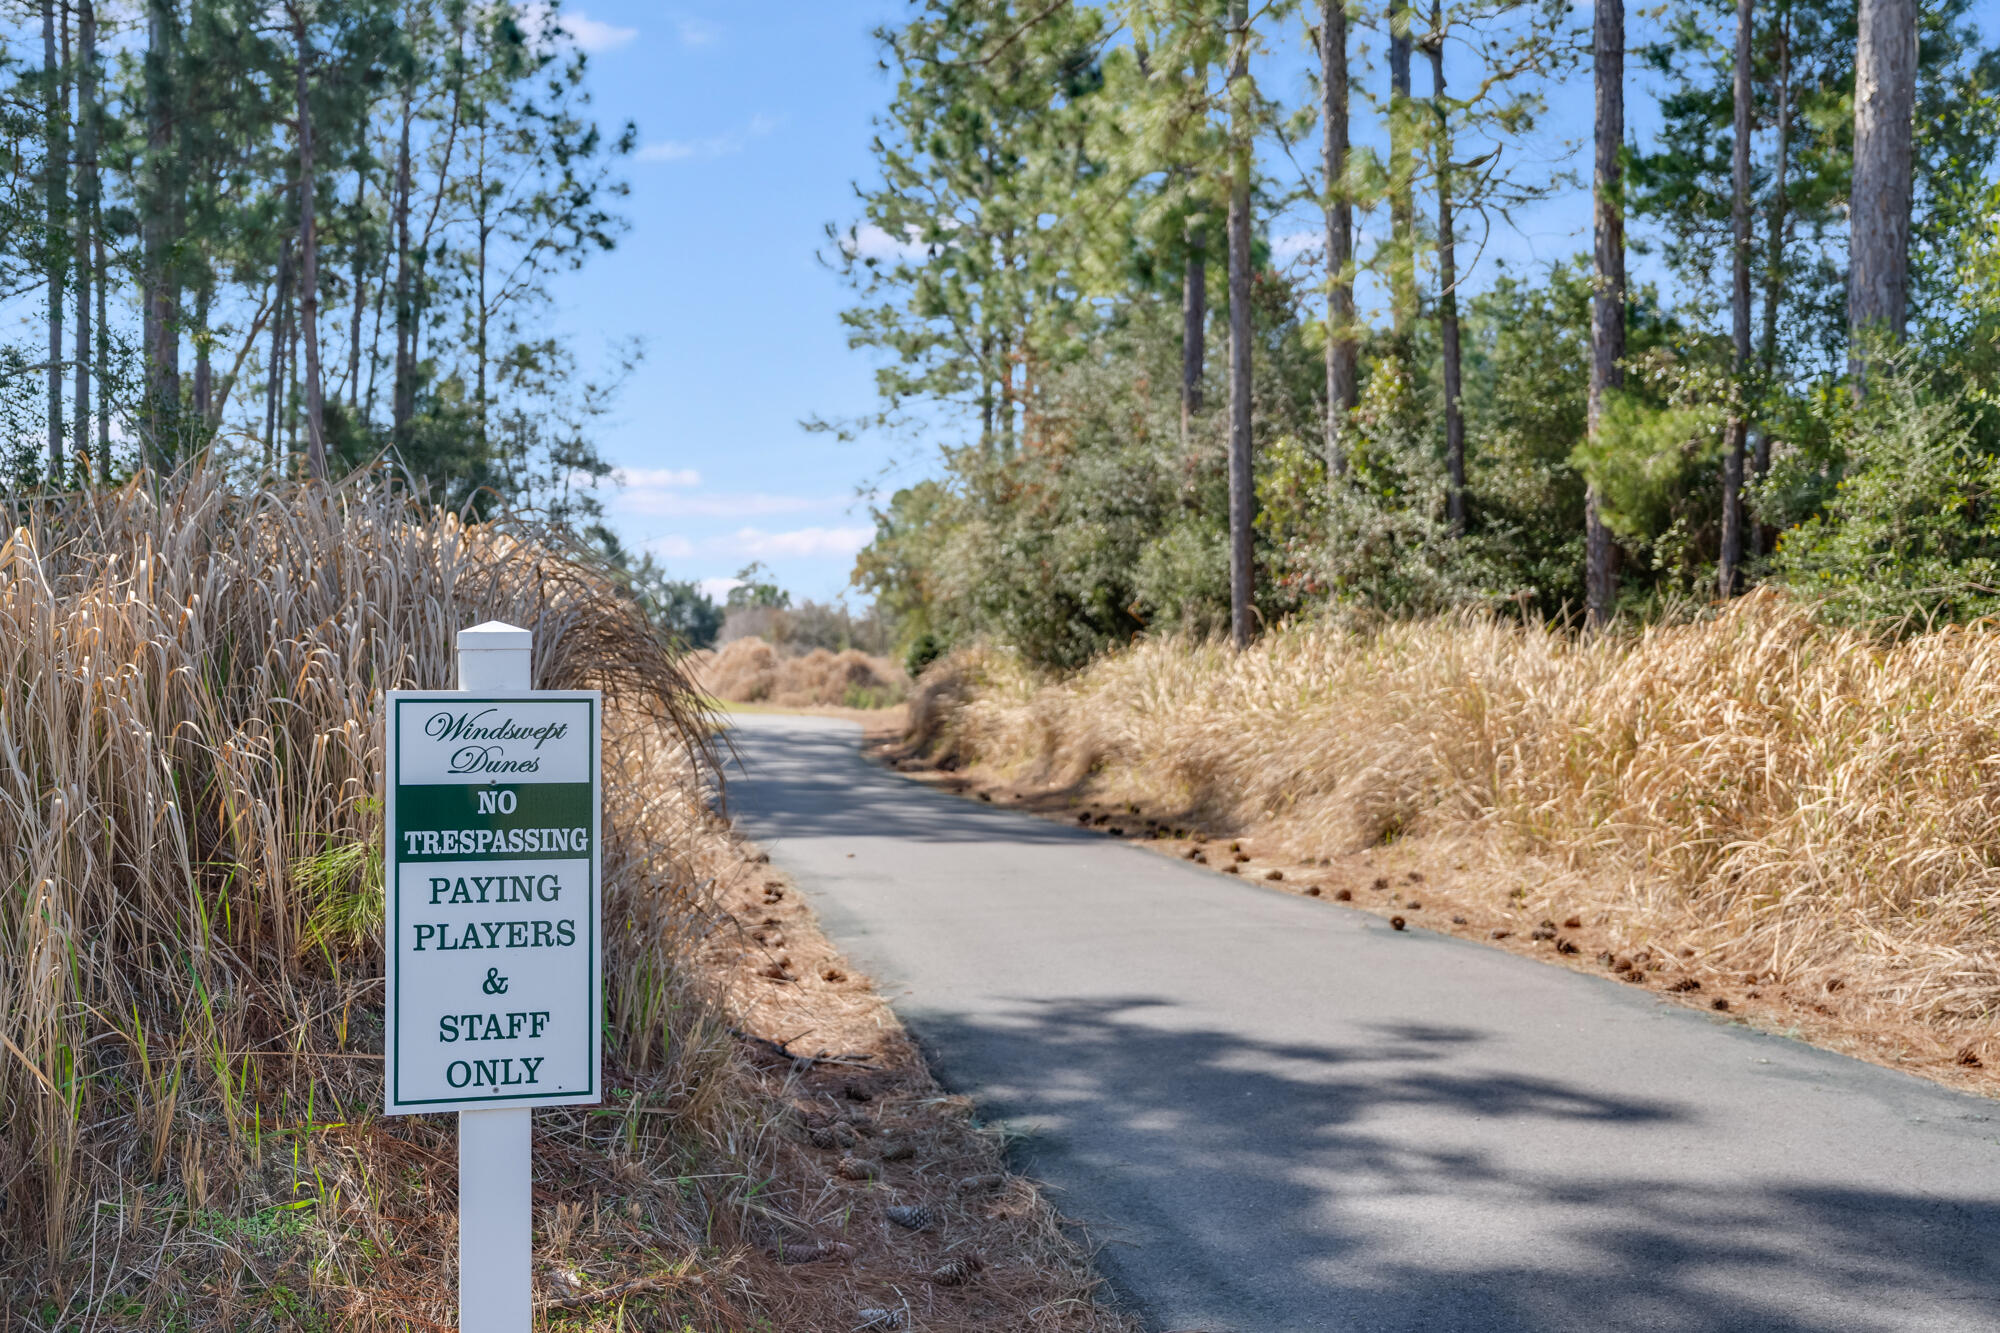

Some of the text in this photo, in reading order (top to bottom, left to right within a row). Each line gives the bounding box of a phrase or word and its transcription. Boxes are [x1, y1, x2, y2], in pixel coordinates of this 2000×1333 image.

[424, 708, 568, 750] Windswept
[447, 745, 541, 774] Dunes
[477, 790, 518, 815] NO
[404, 827, 589, 855] TRESPASSING
[428, 874, 562, 905] PAYING
[412, 919, 576, 951] PLAYERS
[482, 967, 509, 995] &
[439, 1011, 550, 1043] STAFF
[446, 1057, 545, 1088] ONLY
